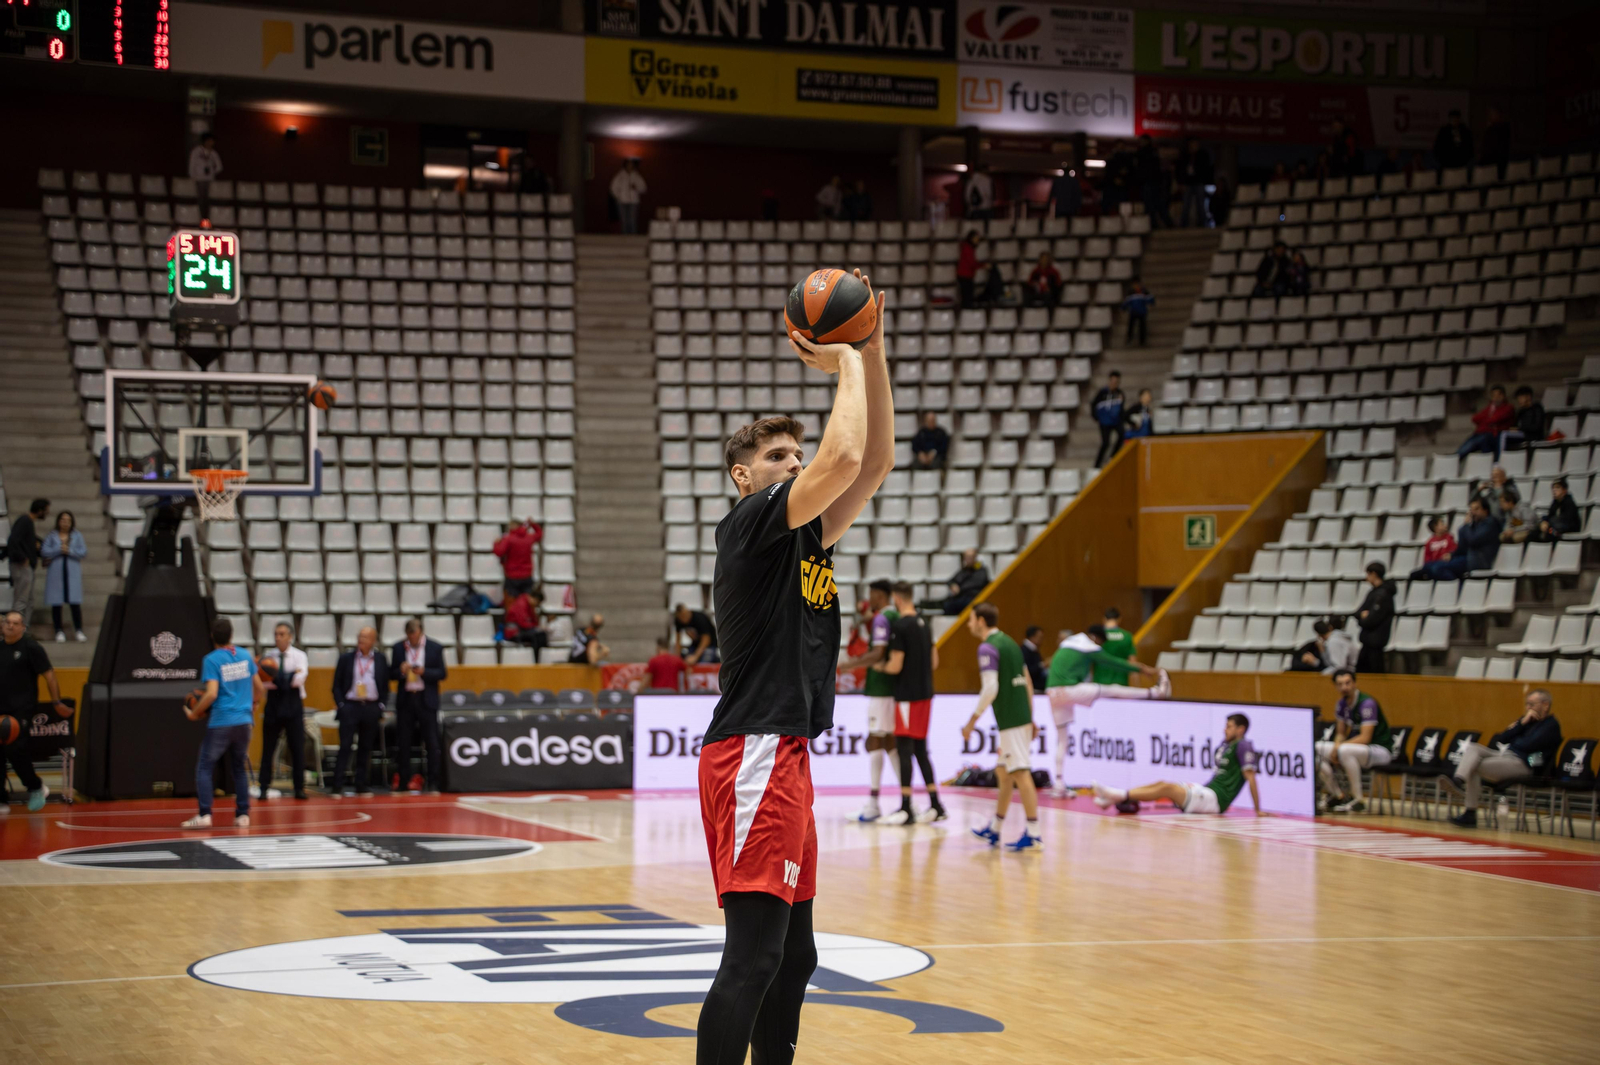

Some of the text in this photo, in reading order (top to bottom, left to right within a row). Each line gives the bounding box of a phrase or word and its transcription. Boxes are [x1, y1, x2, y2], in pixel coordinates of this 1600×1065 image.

[56, 8, 71, 31] 0
[659, 0, 945, 50] SANT DALMAI
[49, 37, 65, 60] 0
[304, 22, 494, 71] parlem
[964, 42, 1042, 61] VALENT
[1160, 21, 1447, 80] L'ESPORTIU
[1008, 82, 1129, 118] fustech
[1145, 91, 1286, 119] BAUHAUS
[184, 253, 231, 290] 24
[29, 720, 70, 737] LDING
[648, 727, 863, 758] Dia Gir
[961, 726, 1049, 754] Dii
[1080, 728, 1136, 762] Girona
[450, 727, 624, 767] endesa
[1150, 733, 1196, 768] Diari
[1254, 750, 1306, 779] rona
